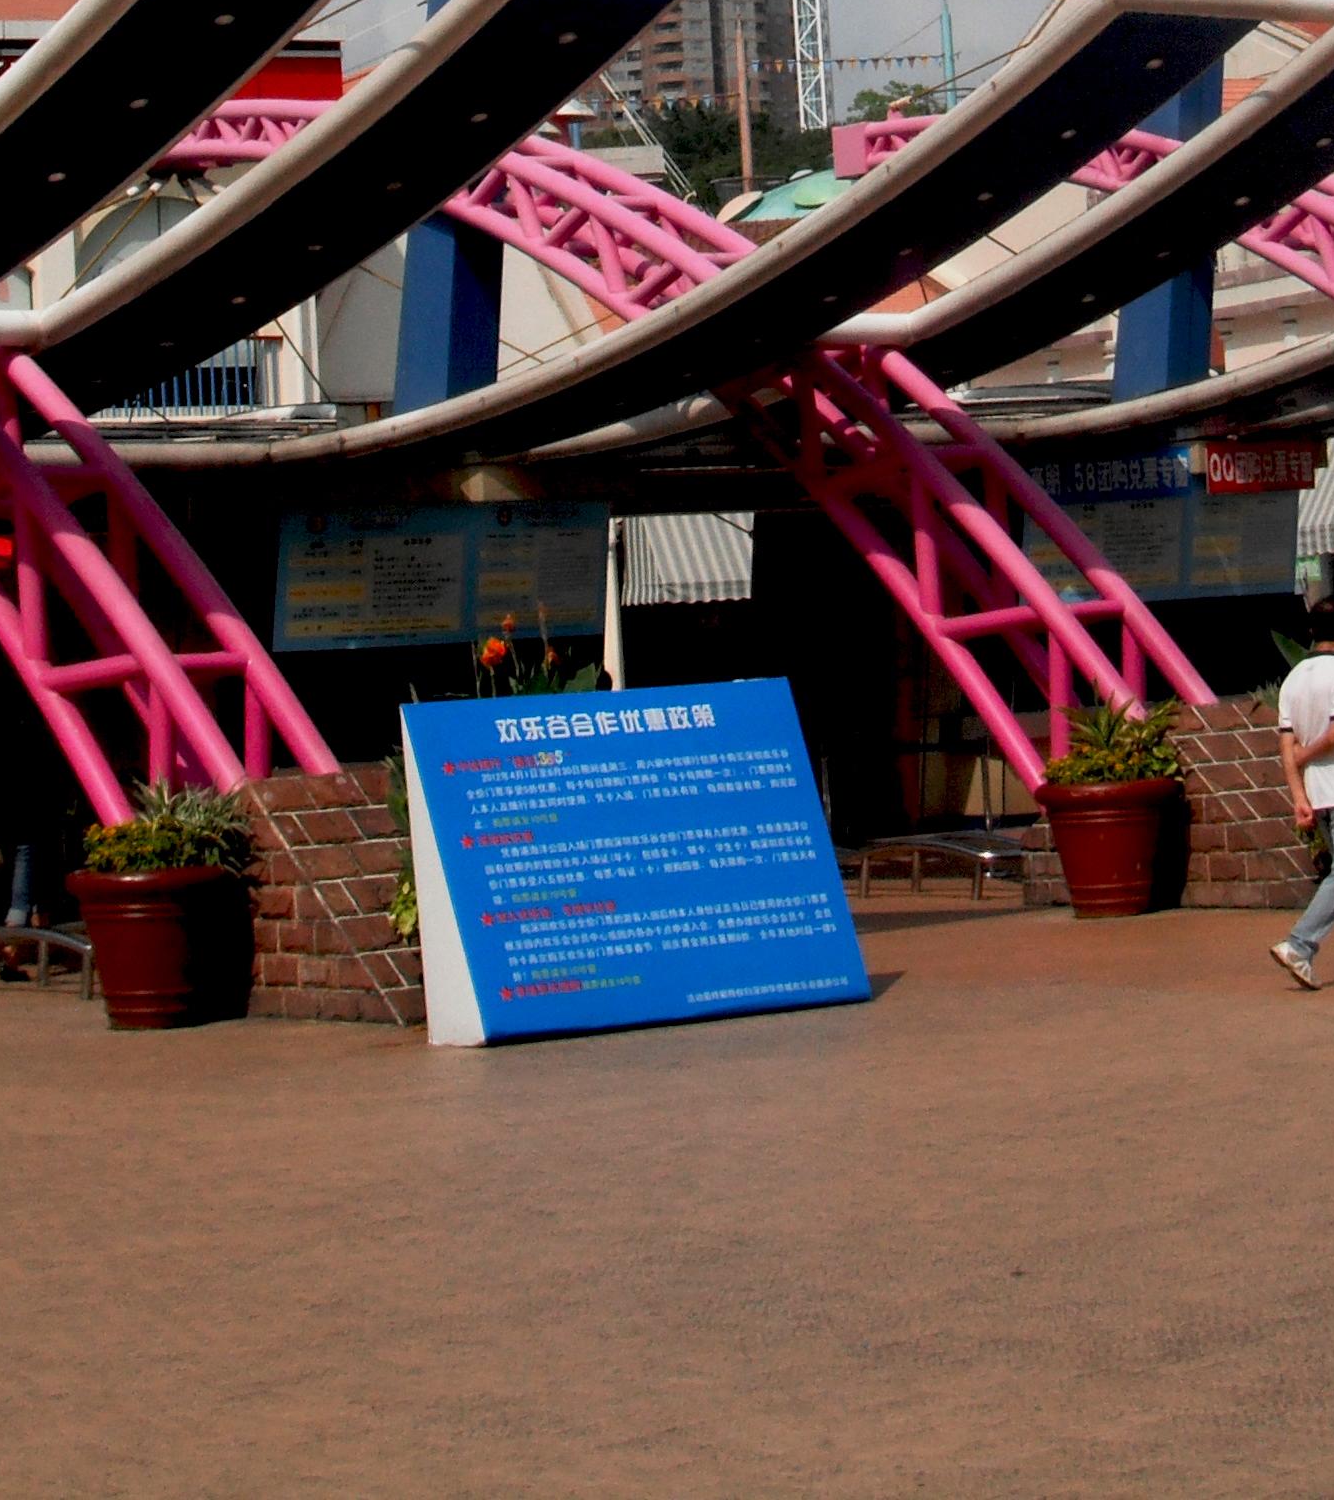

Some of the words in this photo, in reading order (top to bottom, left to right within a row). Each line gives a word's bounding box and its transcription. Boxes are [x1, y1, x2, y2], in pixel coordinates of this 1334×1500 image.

[494, 704, 716, 743] 欢乐谷合作优惠政策
